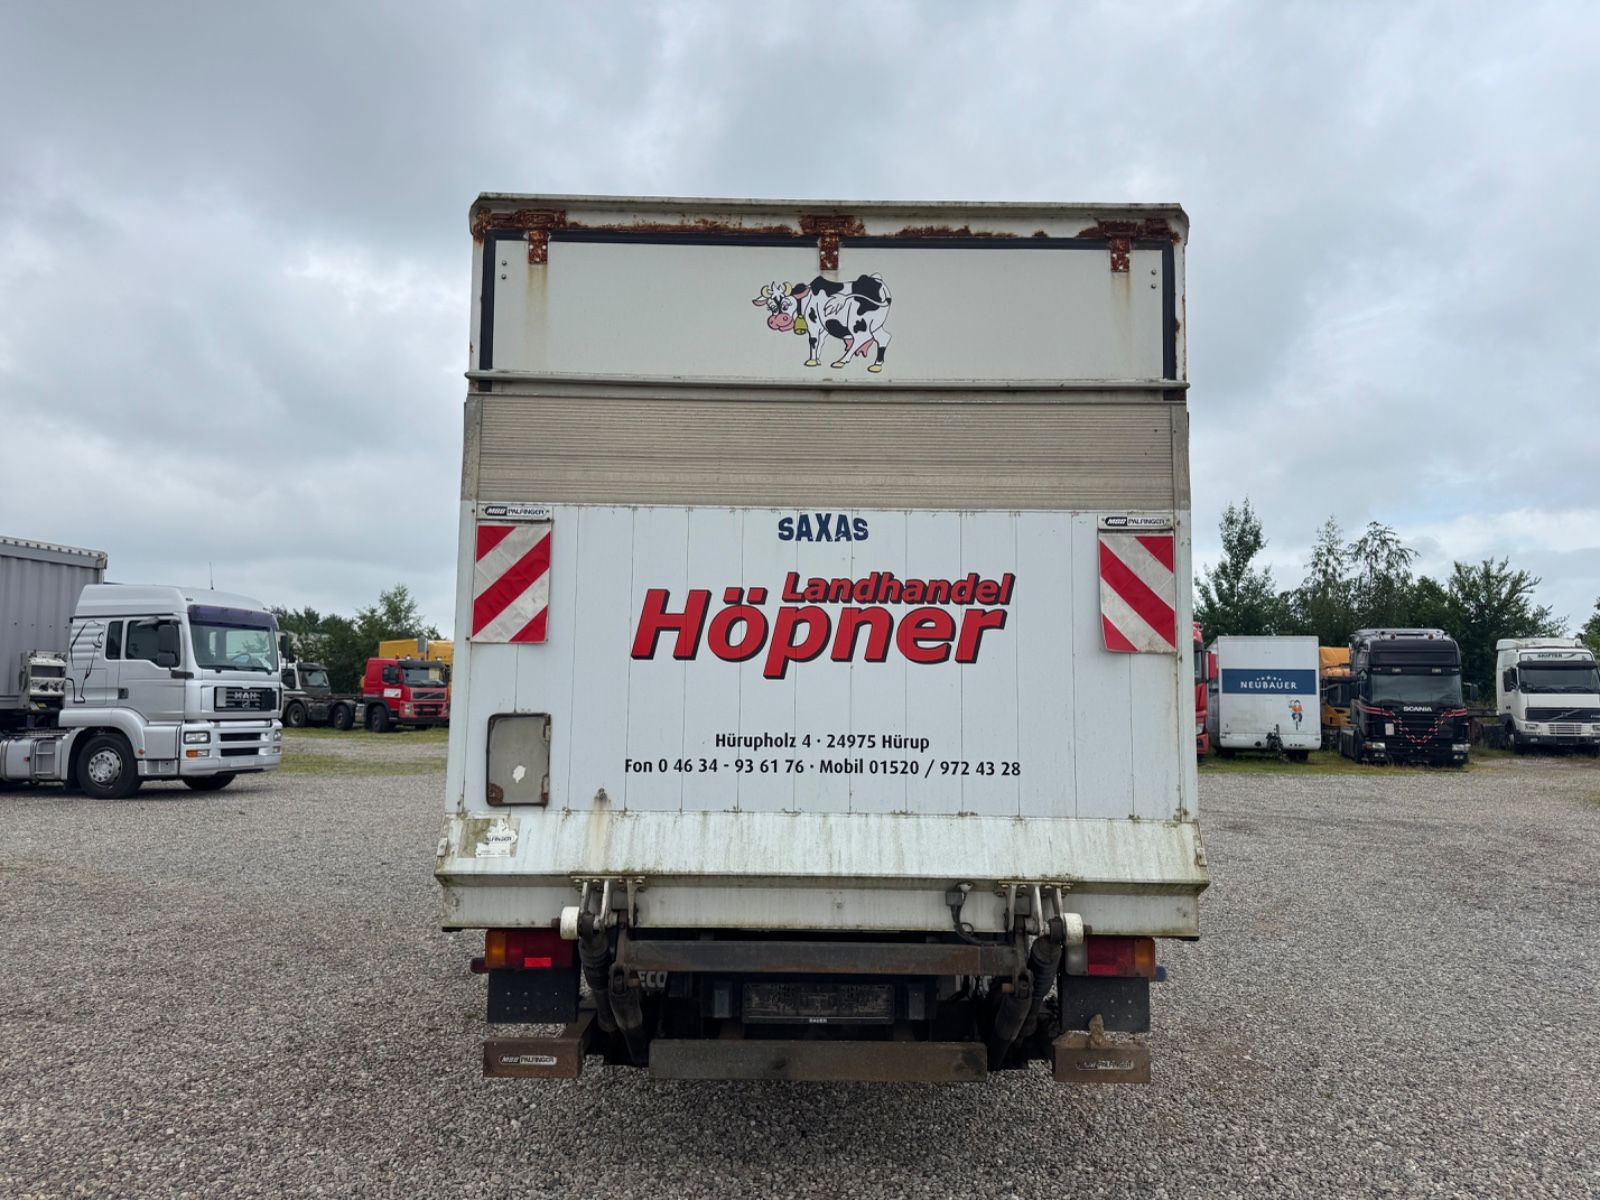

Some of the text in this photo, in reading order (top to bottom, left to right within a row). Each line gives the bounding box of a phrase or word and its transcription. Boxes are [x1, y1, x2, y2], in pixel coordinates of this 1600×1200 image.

[778, 513, 869, 542] SAXAS
[782, 572, 1016, 605] Landhandel
[631, 587, 1008, 680] Höpner
[1240, 681, 1298, 690] NEUBAUER
[715, 732, 797, 752] Hürupholz
[801, 734, 811, 748] 4
[826, 734, 876, 749] 24975
[882, 734, 930, 754] Hürup
[624, 758, 653, 773] Fon
[658, 758, 668, 773] 0
[673, 758, 693, 773] 46
[698, 758, 718, 773] 34
[734, 758, 754, 774] 93
[759, 759, 778, 774] 61
[784, 759, 804, 774] 76
[819, 758, 864, 774] Mobil
[869, 759, 919, 775] 01520
[924, 759, 935, 779] /
[939, 760, 970, 776] 972
[975, 761, 995, 776] 43
[1001, 761, 1021, 777] 28
[636, 970, 669, 988] ECO
